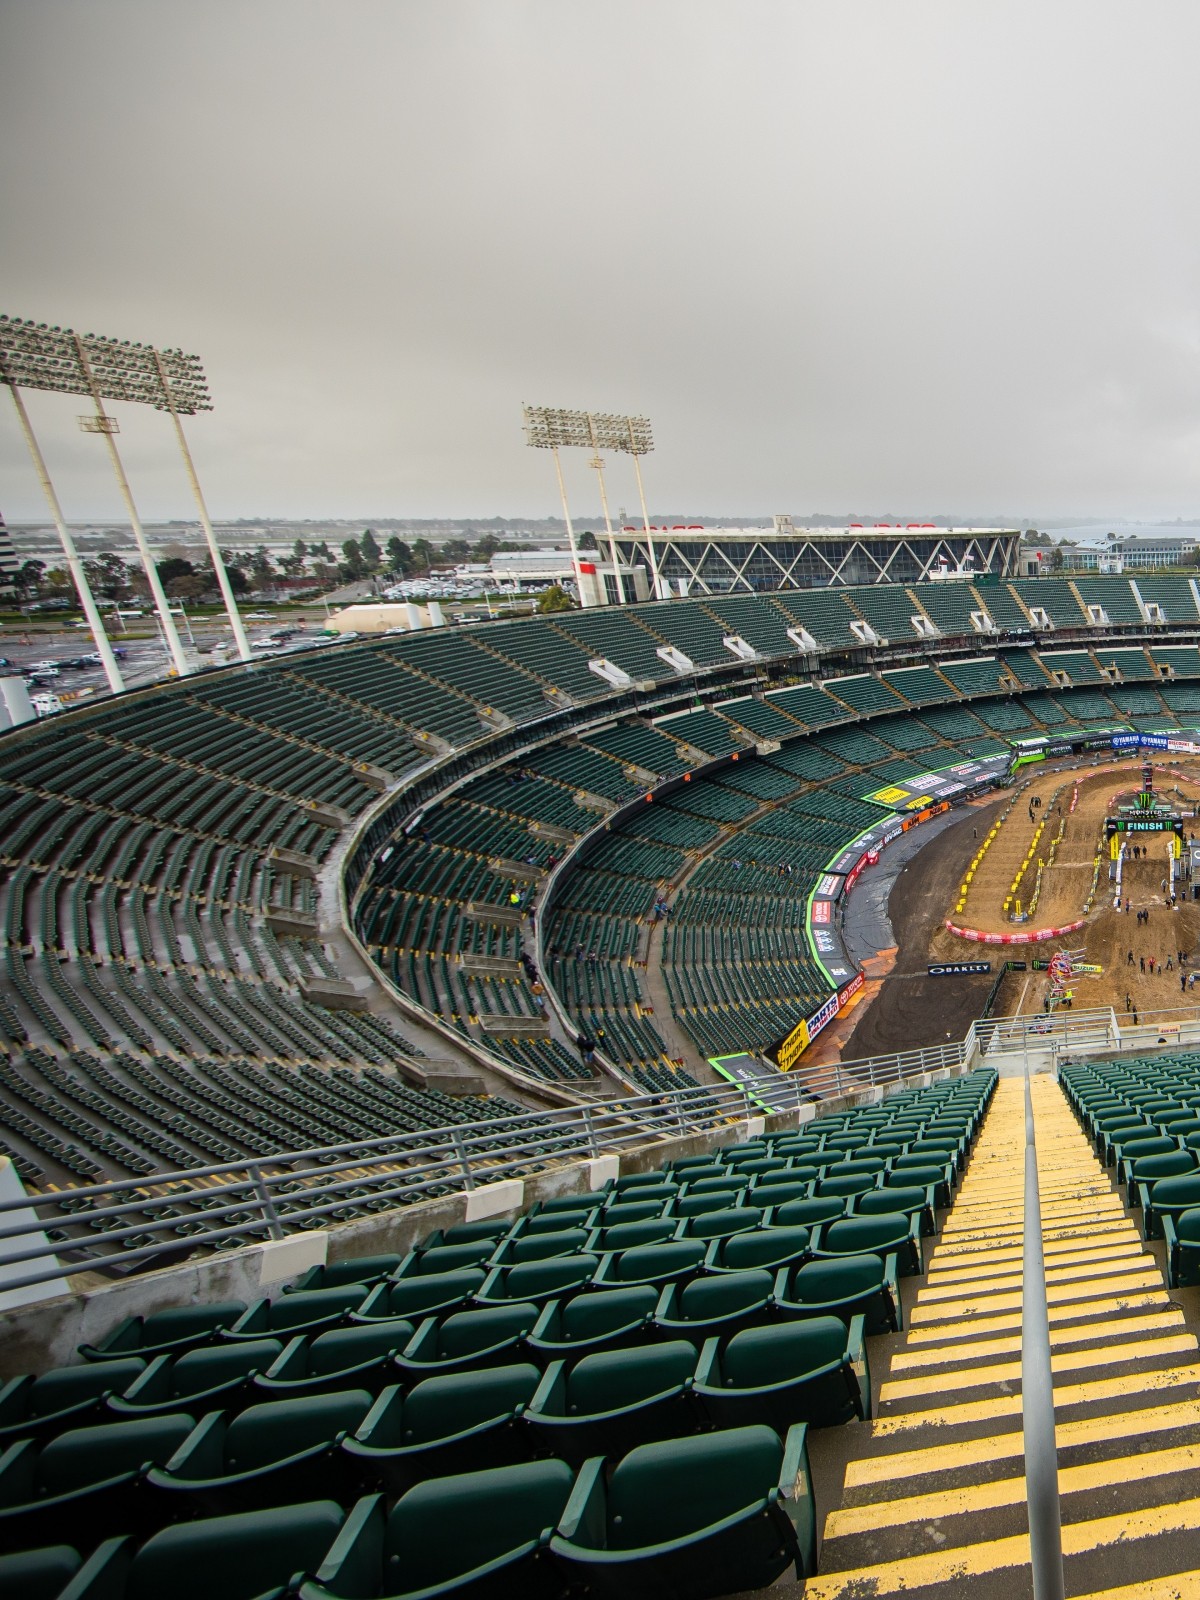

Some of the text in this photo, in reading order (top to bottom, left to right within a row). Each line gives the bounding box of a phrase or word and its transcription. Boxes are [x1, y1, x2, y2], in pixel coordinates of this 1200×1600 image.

[1146, 736, 1167, 744] YAMAHA
[1018, 748, 1043, 757] Kawasaki
[912, 798, 927, 807] THOR
[1127, 822, 1163, 830] FINISH
[945, 965, 989, 973] OAKLEY
[847, 975, 863, 993] TOYOTA
[807, 996, 838, 1032] PARTS
[809, 1004, 838, 1038] UNLIMITED
[783, 1027, 801, 1054] THOR
[784, 1040, 804, 1067] THOR
